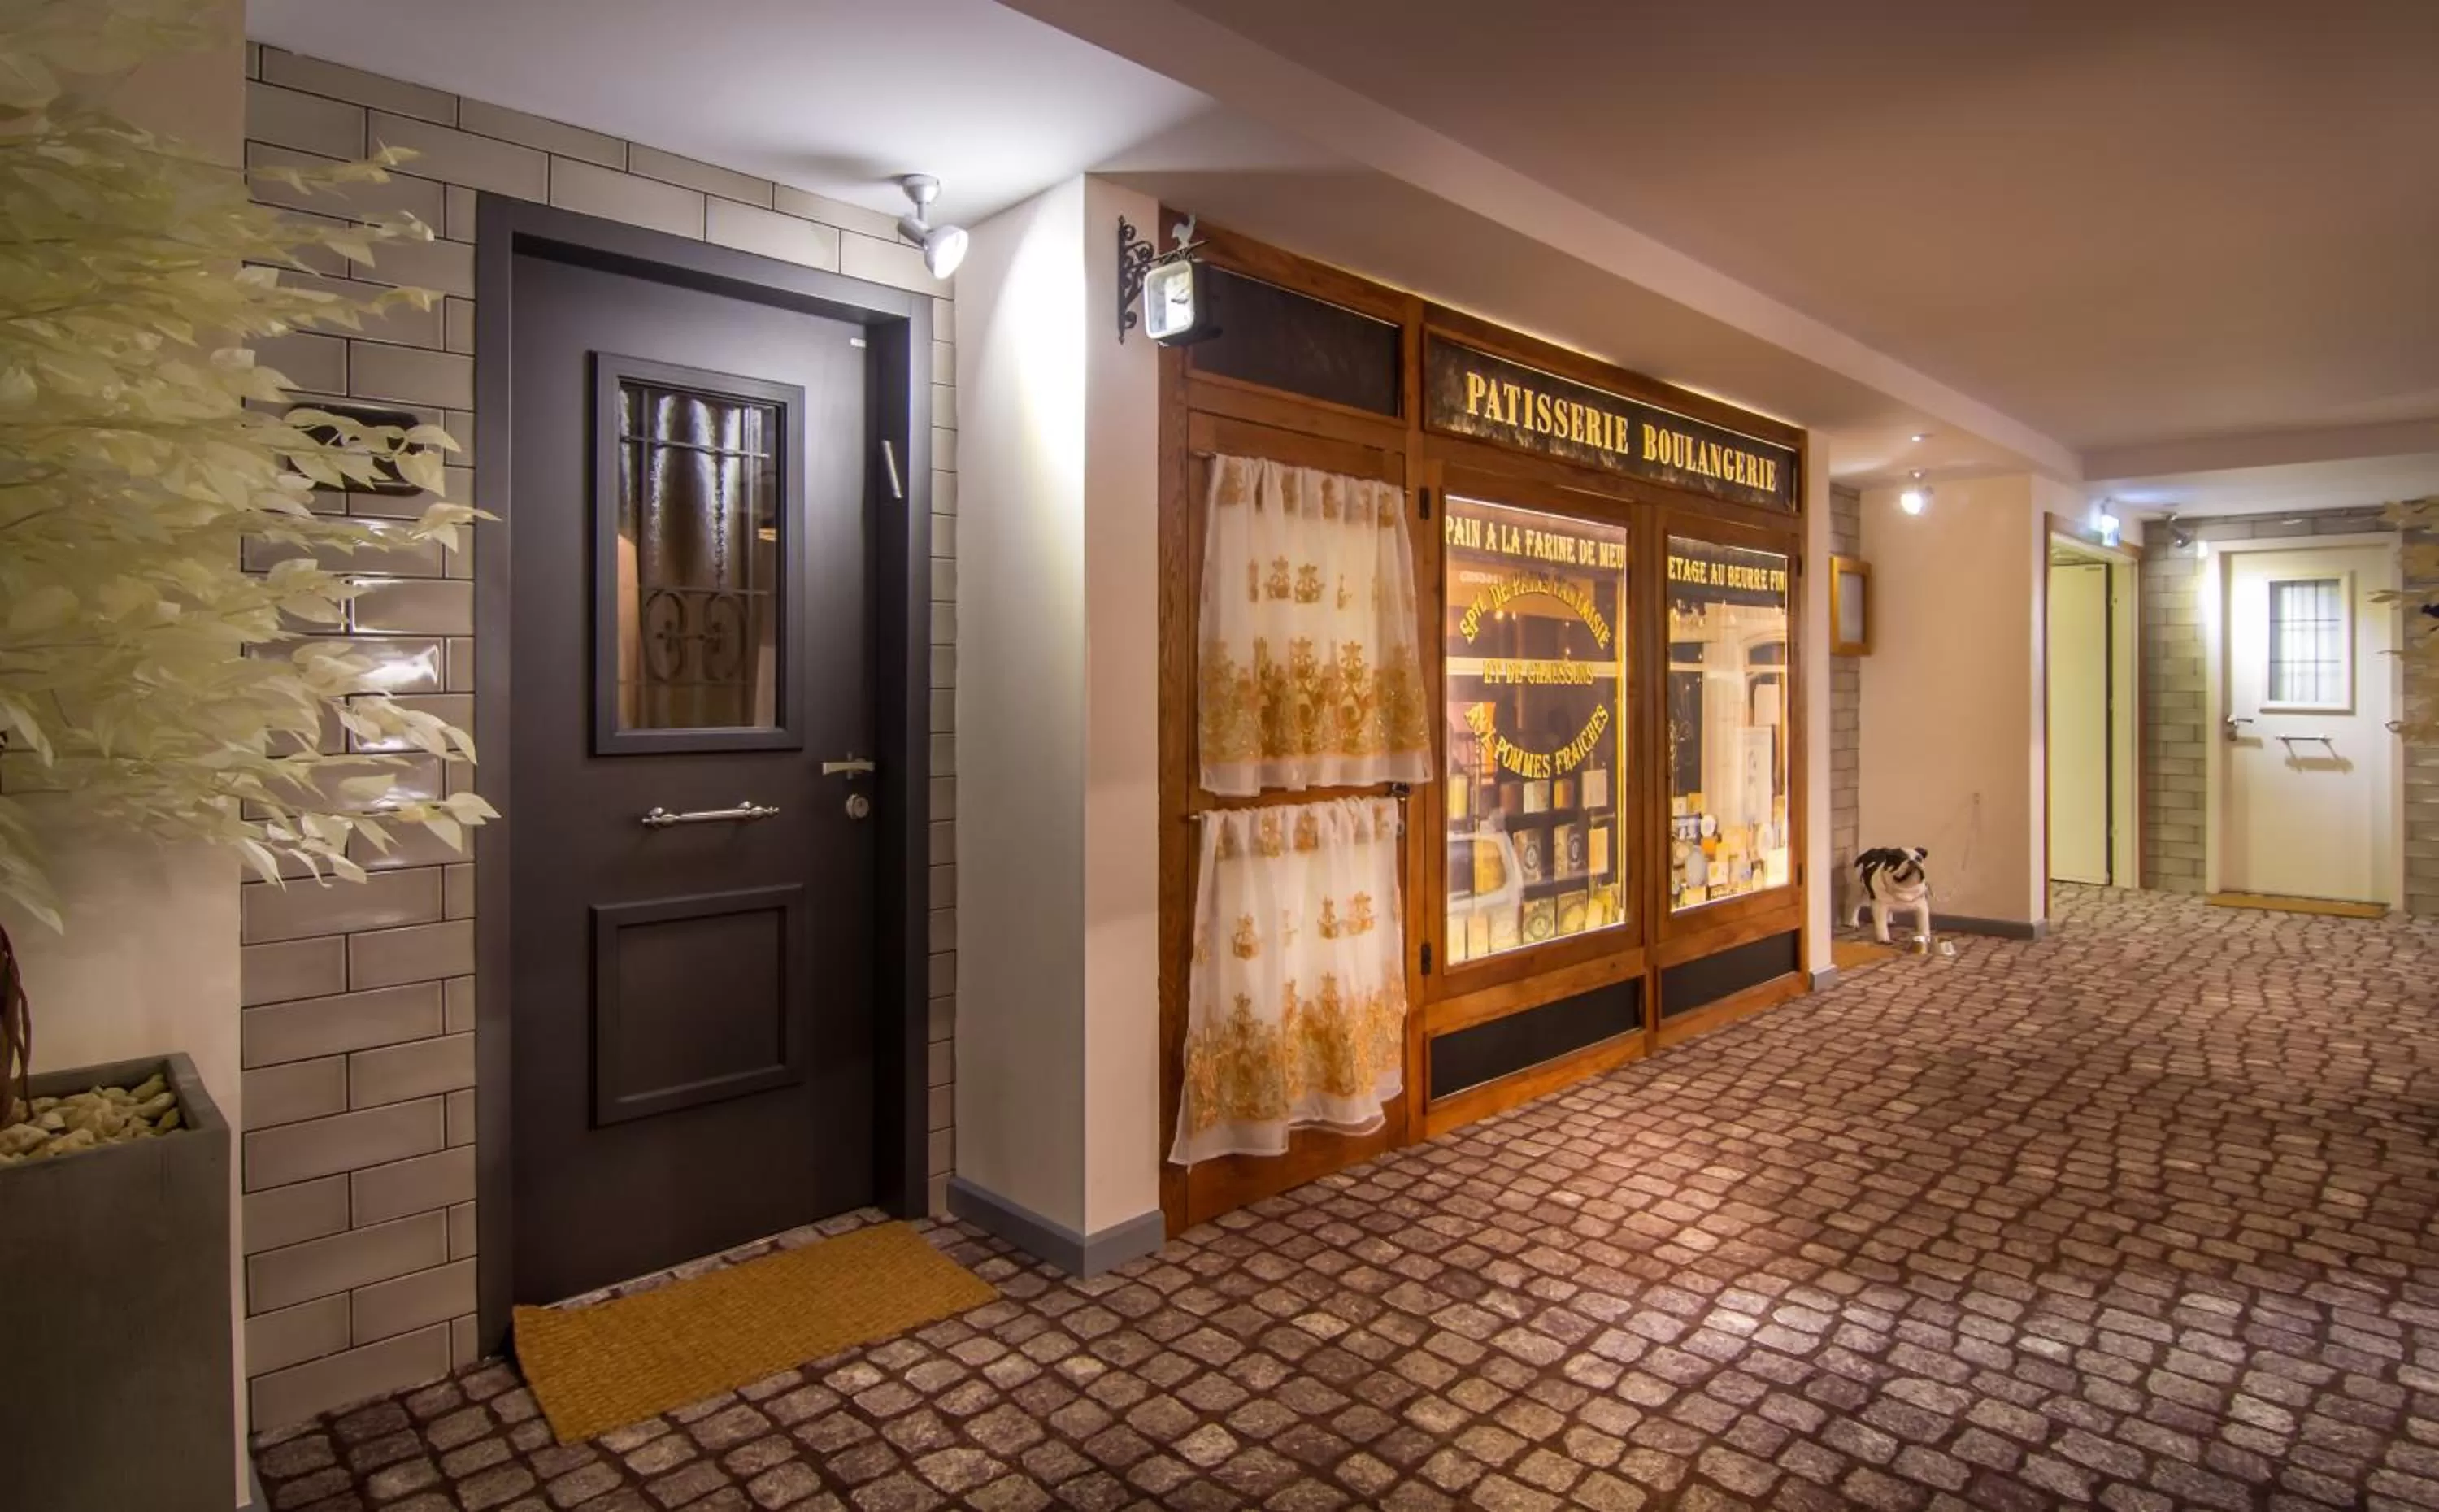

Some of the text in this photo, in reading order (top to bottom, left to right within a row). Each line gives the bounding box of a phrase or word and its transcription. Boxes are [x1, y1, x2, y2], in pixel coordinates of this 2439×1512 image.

[1466, 371, 1776, 492] PATISSERIE BOULANGERIE
[1445, 515, 1480, 547] PAIN
[1486, 523, 1498, 551] A
[1502, 524, 1522, 556] LA
[1525, 529, 1576, 565] FARINE
[1580, 538, 1597, 567] DE
[1667, 555, 1707, 585] ETAGE
[1710, 563, 1726, 586] AU
[1728, 565, 1767, 590] BEURRE
[1495, 735, 1551, 778] POMMES
[1554, 703, 1609, 775] FRAICHES
